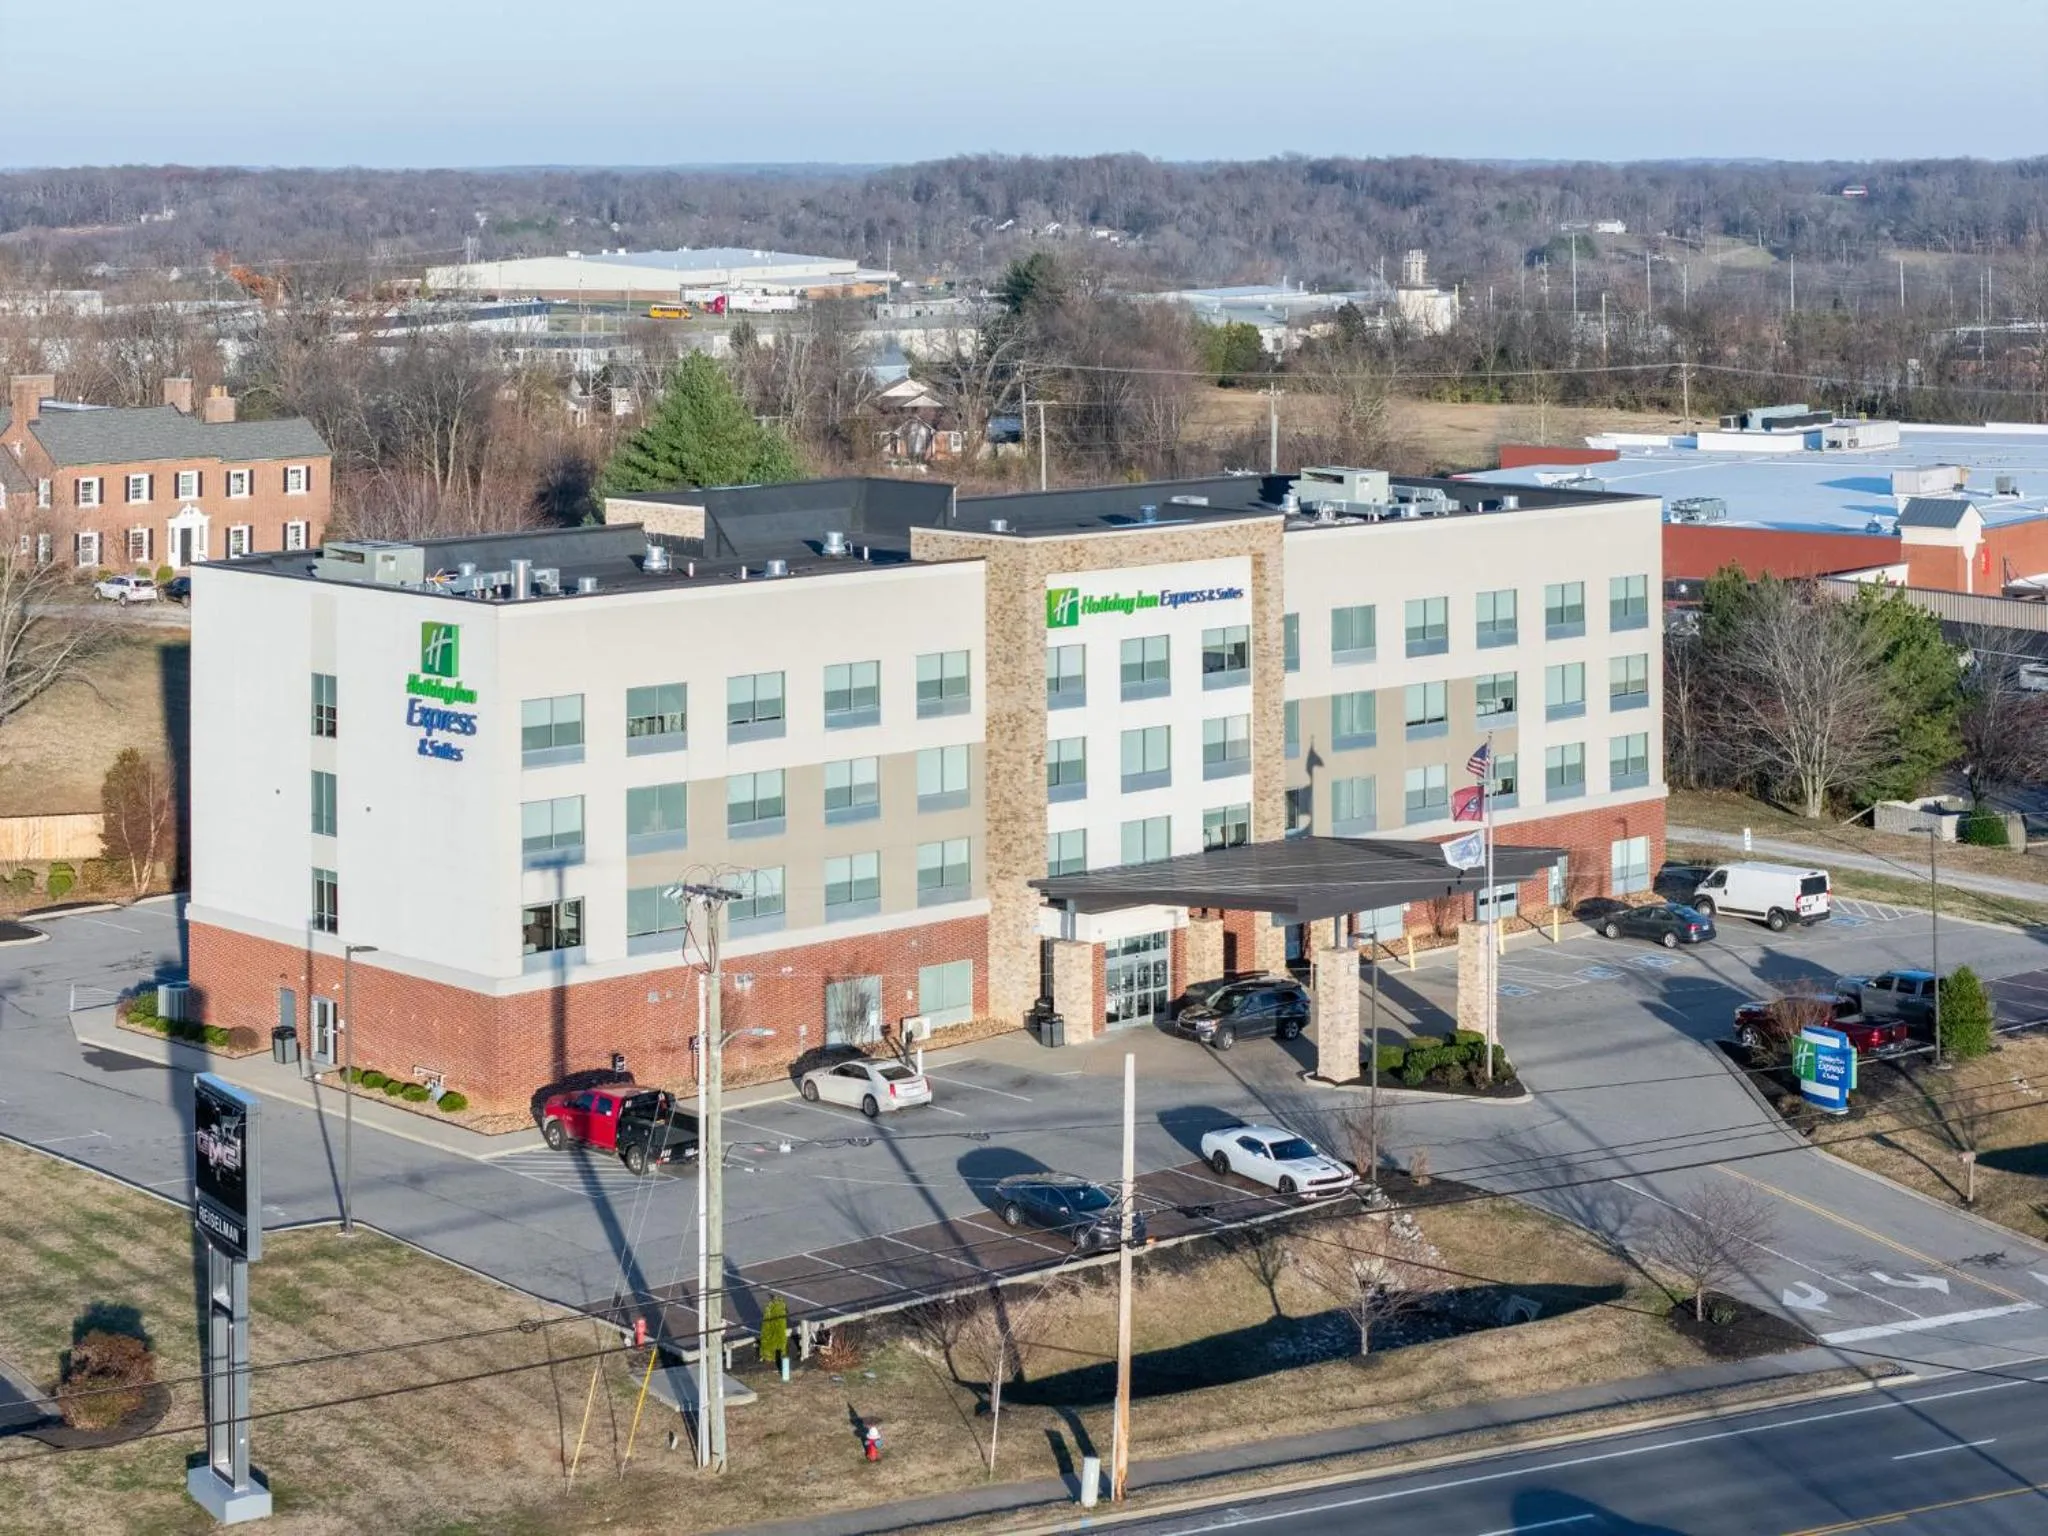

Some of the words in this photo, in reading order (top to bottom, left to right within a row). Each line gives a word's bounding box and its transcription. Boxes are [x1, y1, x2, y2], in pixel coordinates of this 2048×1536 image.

[1081, 592, 1136, 615] Holiday
[1136, 590, 1159, 609] Inn
[1160, 589, 1207, 609] Express
[406, 698, 477, 736] Express
[198, 1205, 240, 1245] REISELMAN
